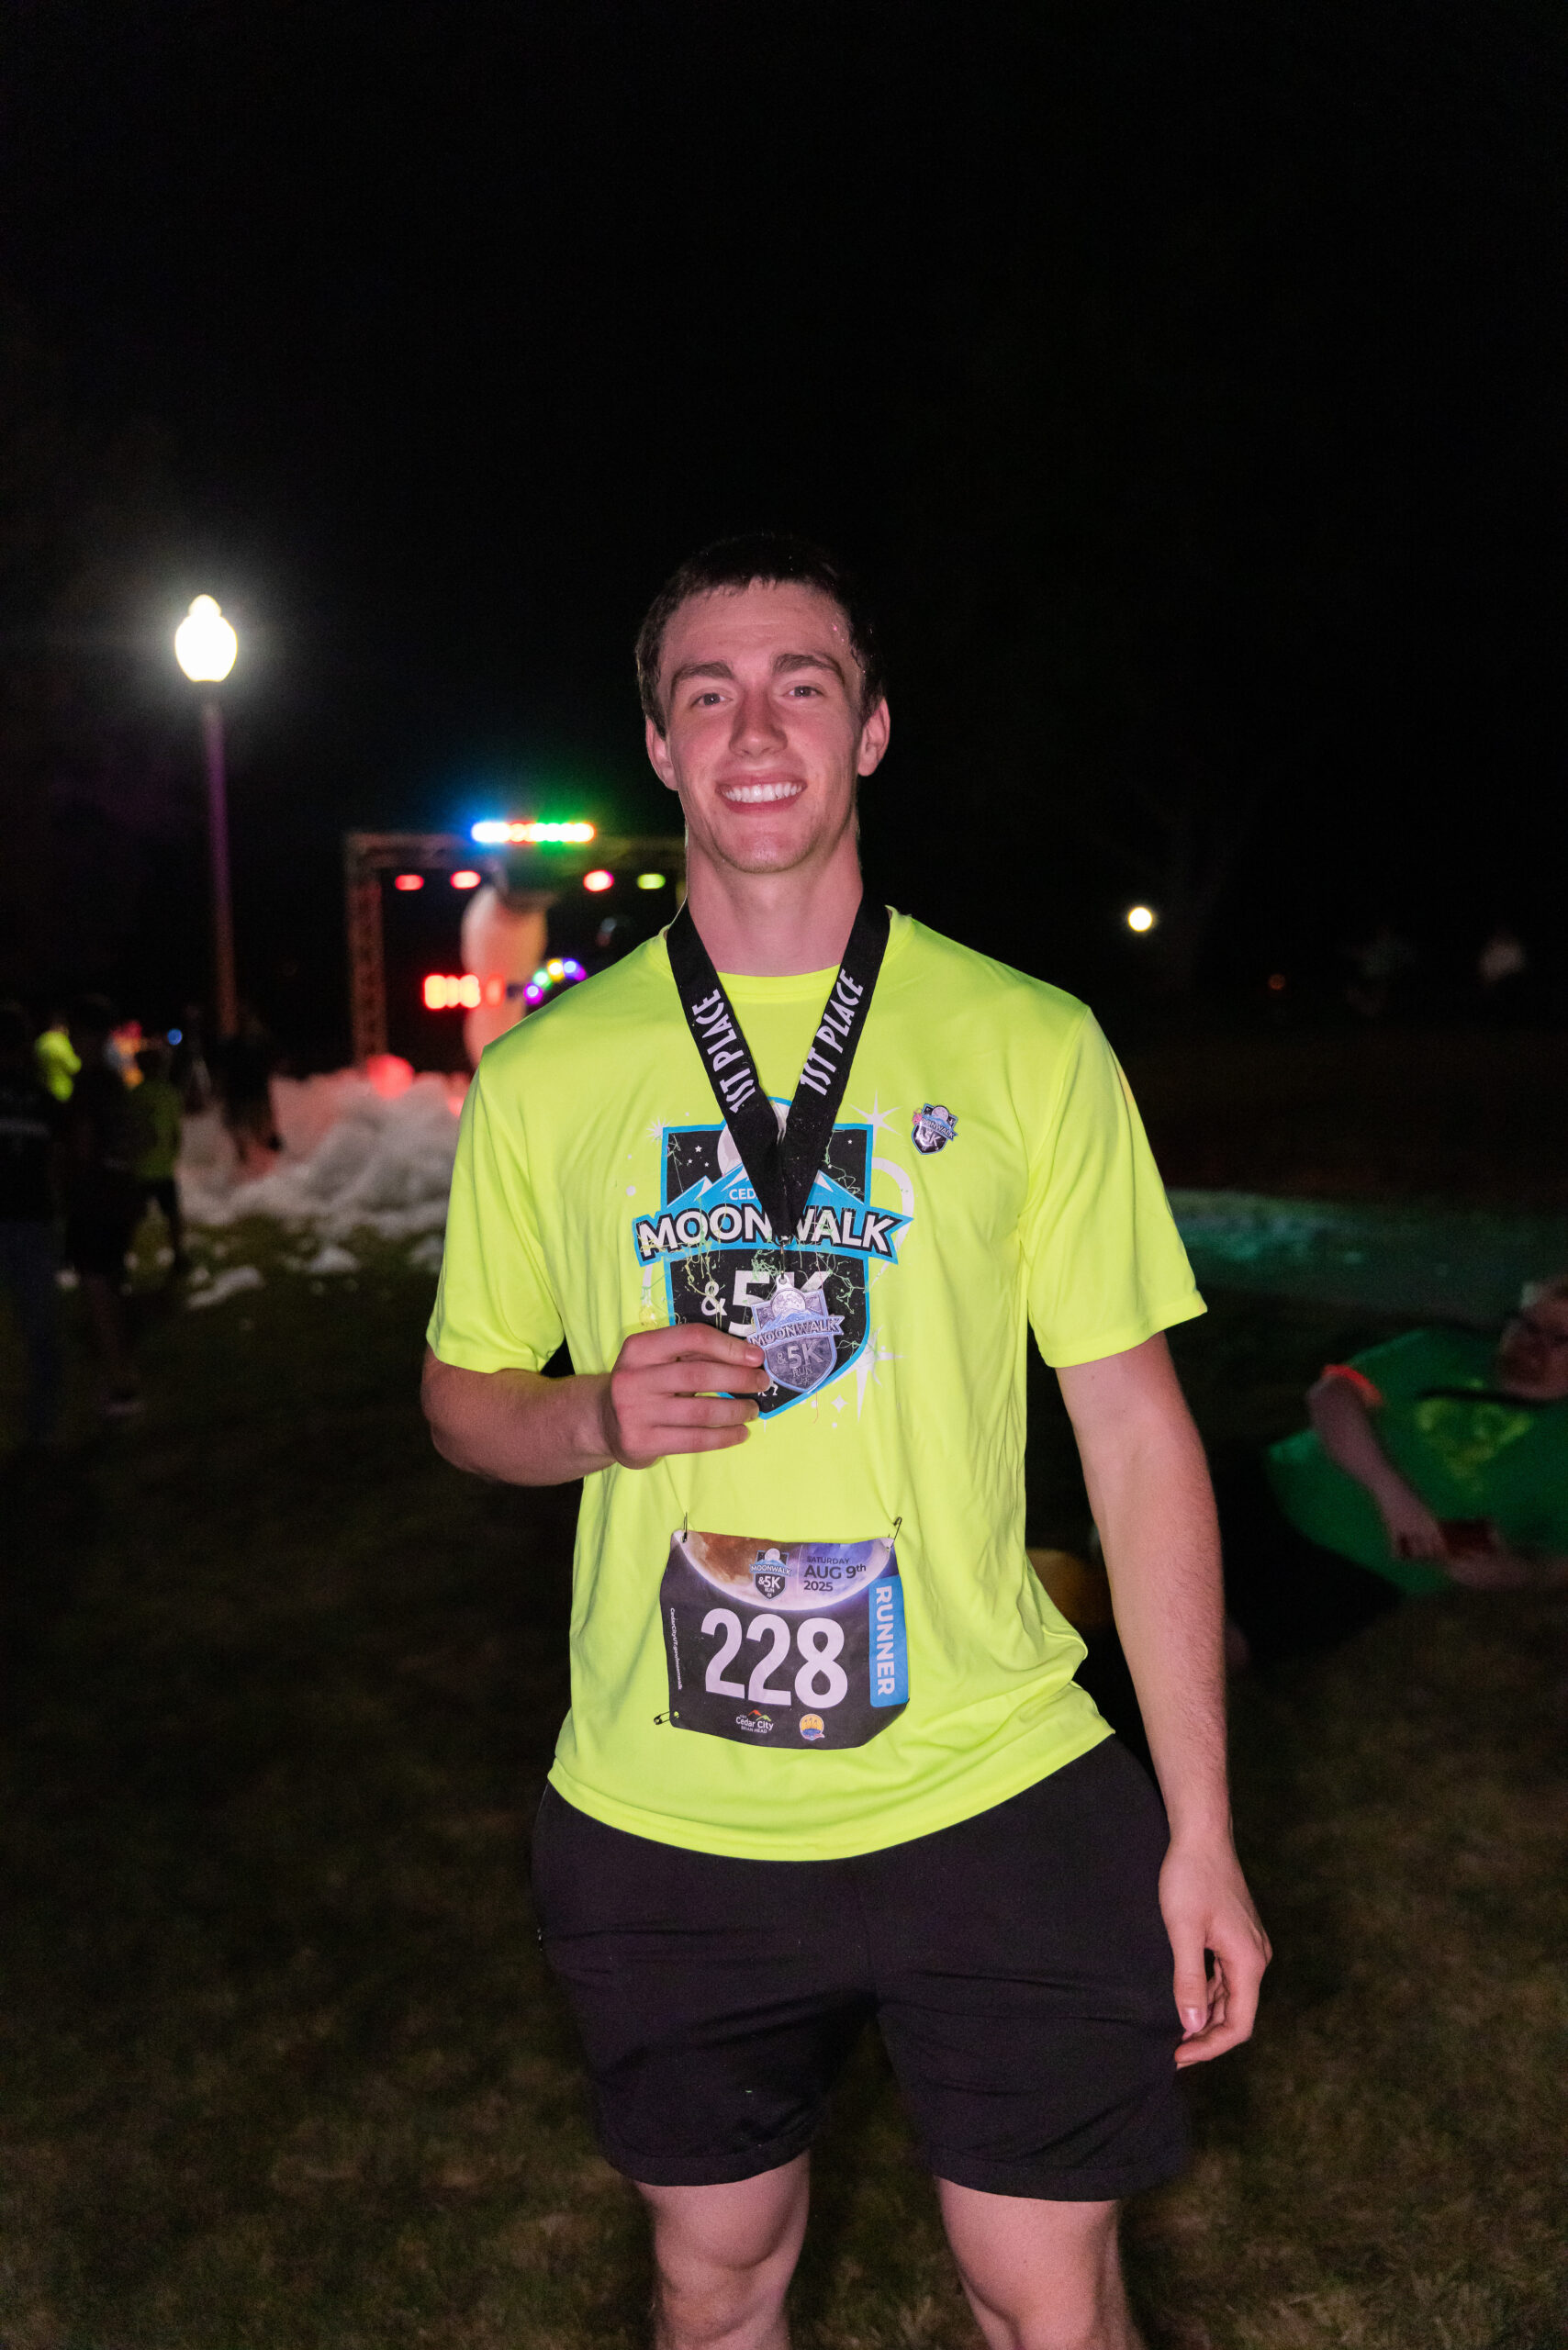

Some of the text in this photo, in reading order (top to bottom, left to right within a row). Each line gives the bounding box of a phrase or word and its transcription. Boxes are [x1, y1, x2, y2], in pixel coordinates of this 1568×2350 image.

[800, 968, 864, 1096] 1ST PLACE
[691, 989, 756, 1113] 1ST PLACE
[729, 1188, 756, 1201] CED
[750, 1318, 839, 1347] MOONWALK
[787, 1339, 824, 1369] 5K
[750, 1564, 791, 1576] MOONWALK
[804, 1563, 867, 1580] AUG 9th
[807, 1556, 850, 1564] SATURDAY
[803, 1580, 834, 1592] 2025
[876, 1585, 896, 1696] RUNNER
[700, 1607, 849, 1709] 228
[735, 1717, 756, 1728] Cedar
[756, 1720, 774, 1731] City
